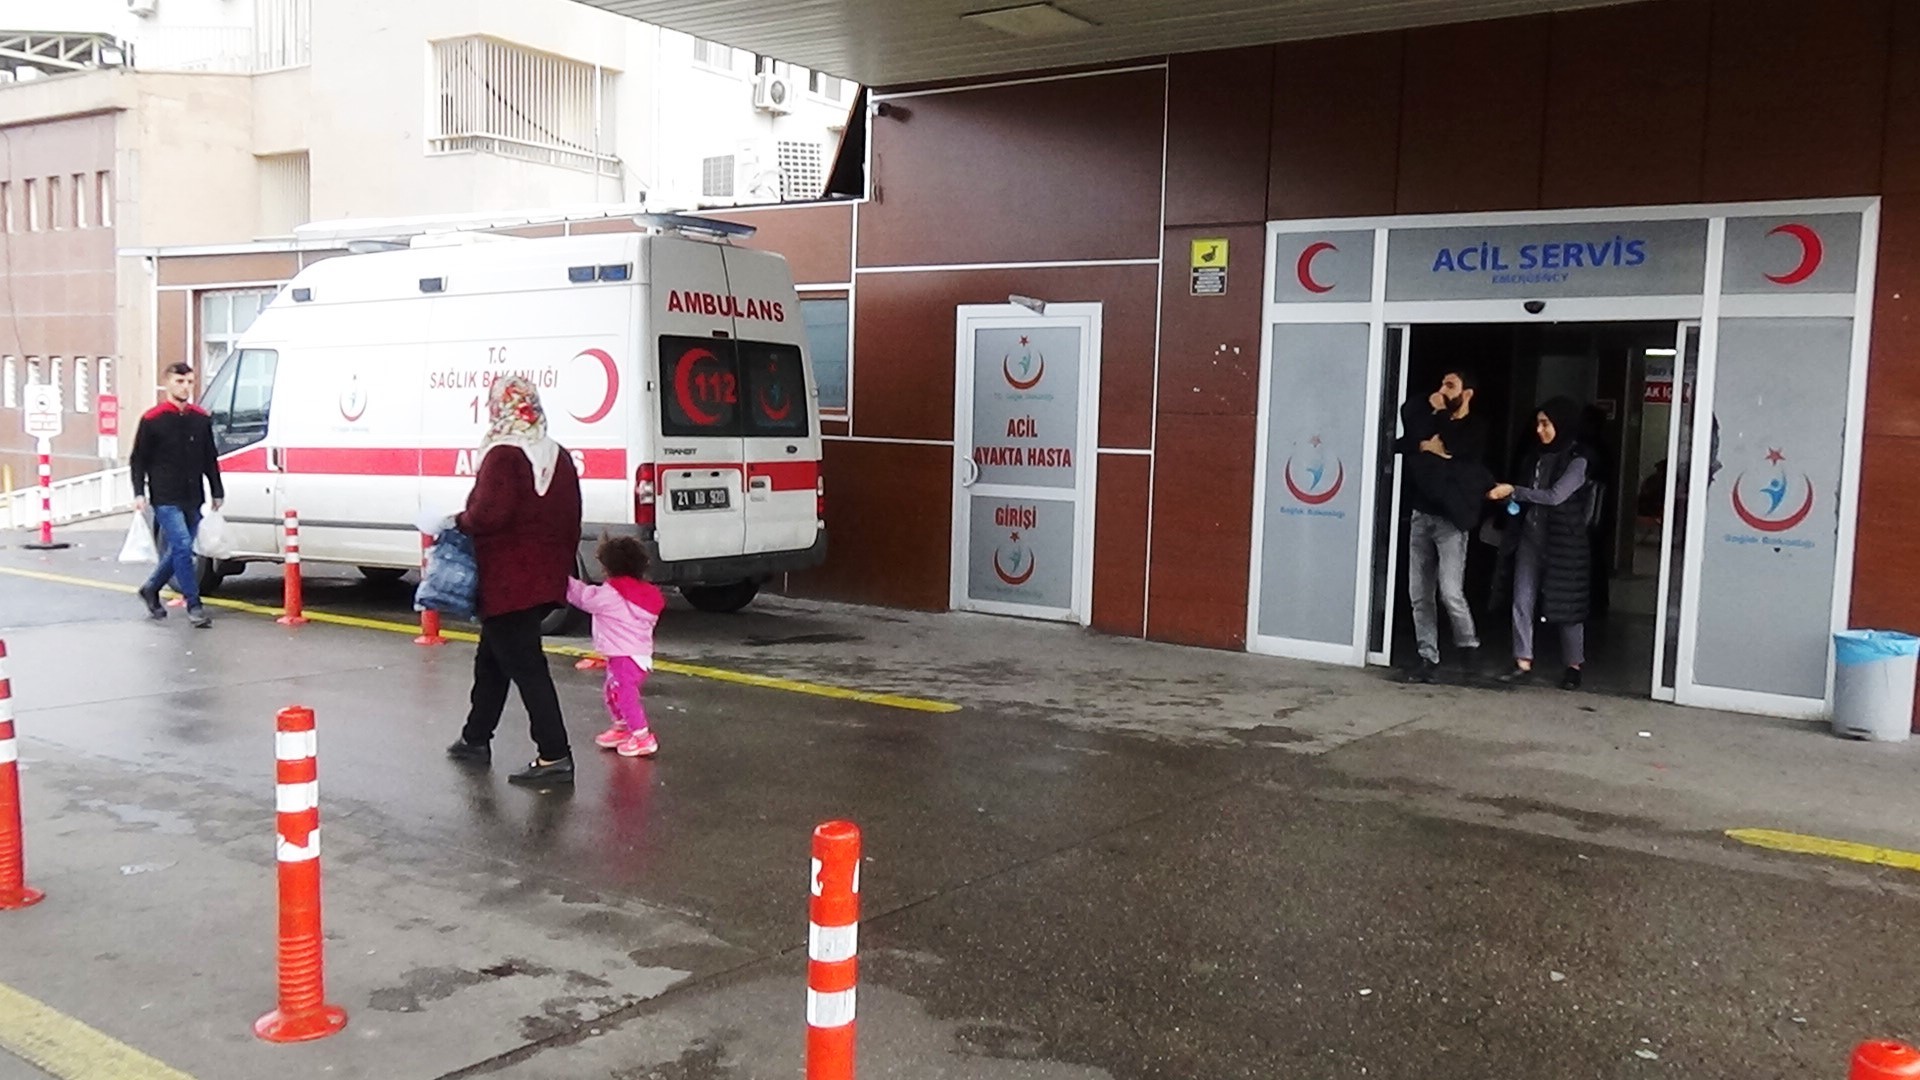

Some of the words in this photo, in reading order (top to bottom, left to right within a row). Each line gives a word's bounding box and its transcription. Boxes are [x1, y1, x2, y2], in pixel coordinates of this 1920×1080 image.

[1432, 241, 1509, 272] ACİL
[1519, 235, 1646, 270] SERVİS
[668, 289, 785, 323] AMBULANS
[430, 367, 478, 389] SAĞLIK
[482, 365, 559, 389] BANLIĞI
[695, 372, 738, 404] 112
[1006, 414, 1038, 438] ACİL
[974, 446, 1023, 466] AYAKTA
[1027, 447, 1072, 468] HASTA
[677, 491, 689, 506] 21
[995, 504, 1036, 530] GİRİŞİ
